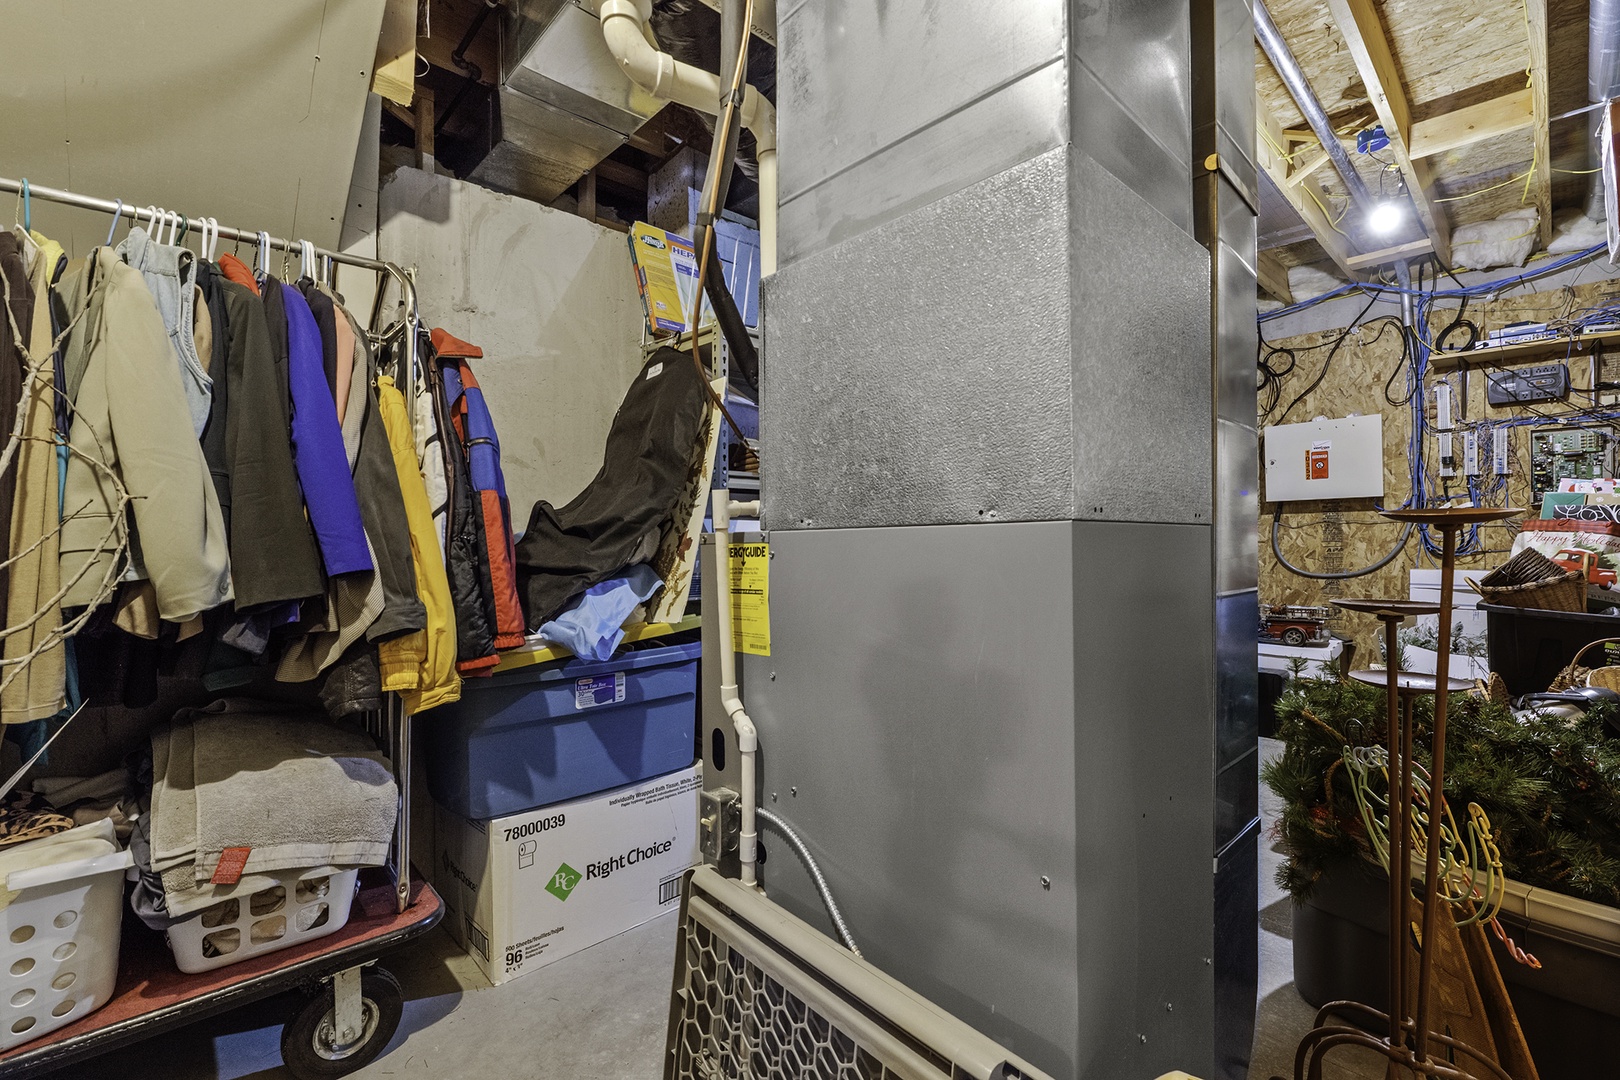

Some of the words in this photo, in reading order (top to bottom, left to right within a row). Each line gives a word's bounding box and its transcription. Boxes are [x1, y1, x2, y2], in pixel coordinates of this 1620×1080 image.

[1527, 530, 1569, 546] Happy
[729, 546, 766, 558] ERGYGUIDE
[609, 794, 635, 806] Individually
[636, 788, 655, 799] Wrapped
[503, 813, 566, 843] 78000039
[586, 854, 625, 880] Right
[627, 840, 672, 866] Choice
[554, 872, 576, 891] RC
[505, 949, 523, 966] 96
